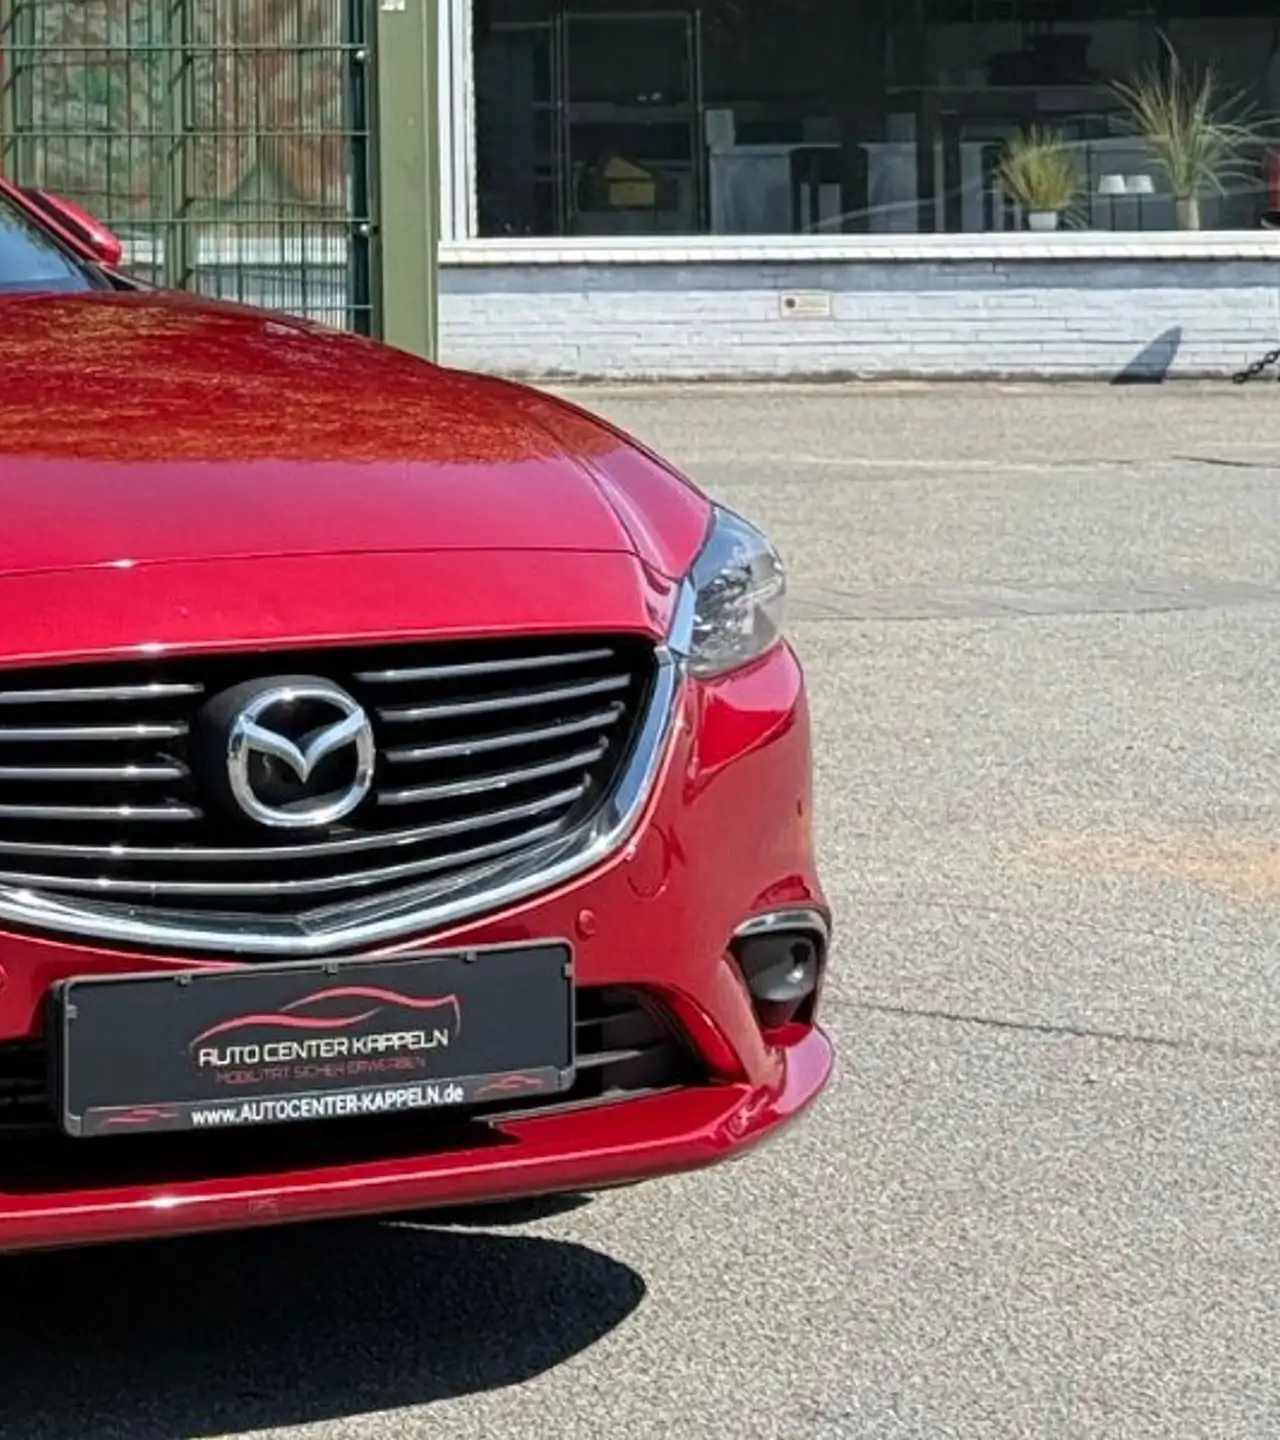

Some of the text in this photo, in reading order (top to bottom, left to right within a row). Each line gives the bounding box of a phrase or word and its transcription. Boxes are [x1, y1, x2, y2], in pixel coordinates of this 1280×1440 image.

[198, 1028, 449, 1067] AUTO CENTER KAPPELN
[190, 1081, 465, 1126] www.AUTOCENTER-KAPPELN.de
